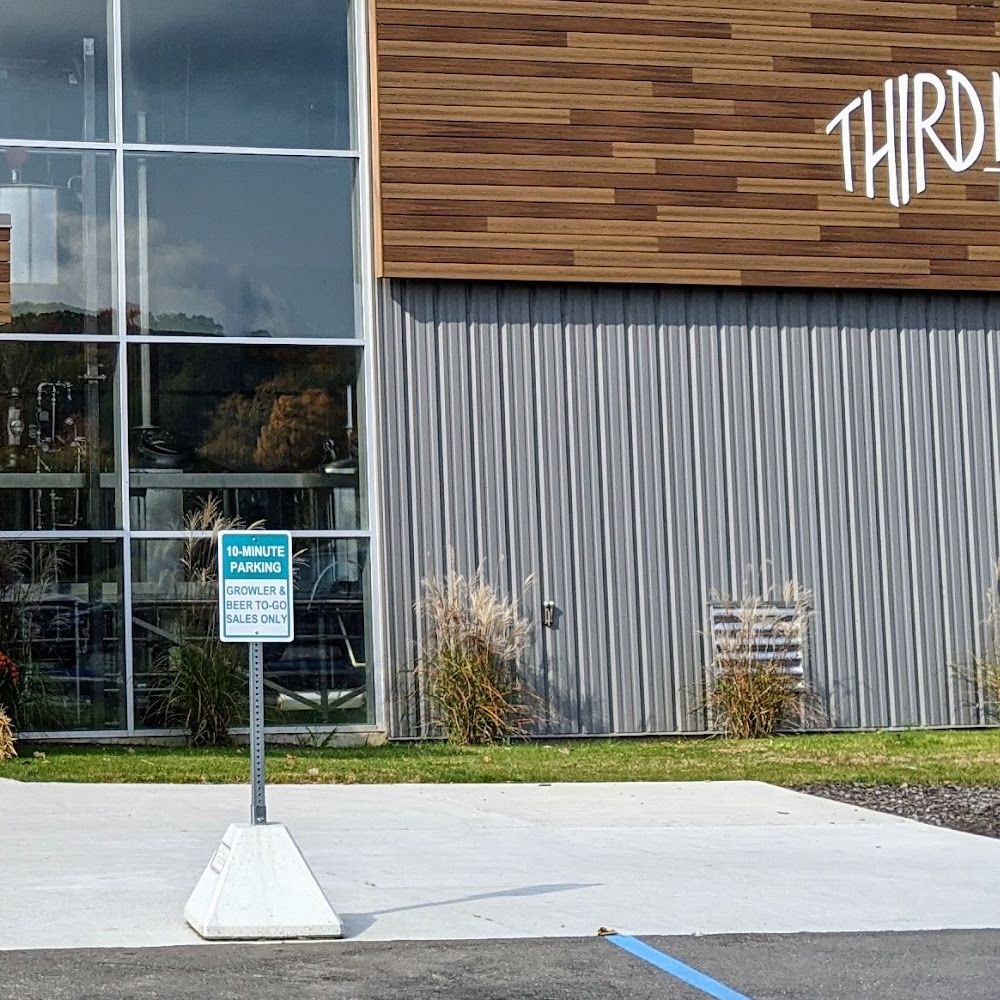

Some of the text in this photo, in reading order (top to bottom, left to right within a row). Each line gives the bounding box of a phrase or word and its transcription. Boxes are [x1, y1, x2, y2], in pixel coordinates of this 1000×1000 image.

[826, 69, 985, 207] THIRD
[226, 545, 285, 557] 10-MINUTE
[230, 561, 281, 573] PARKING
[226, 586, 286, 595] GROWLER &
[226, 600, 287, 610] BEER TO-GO
[226, 614, 288, 624] SALES ONLY
